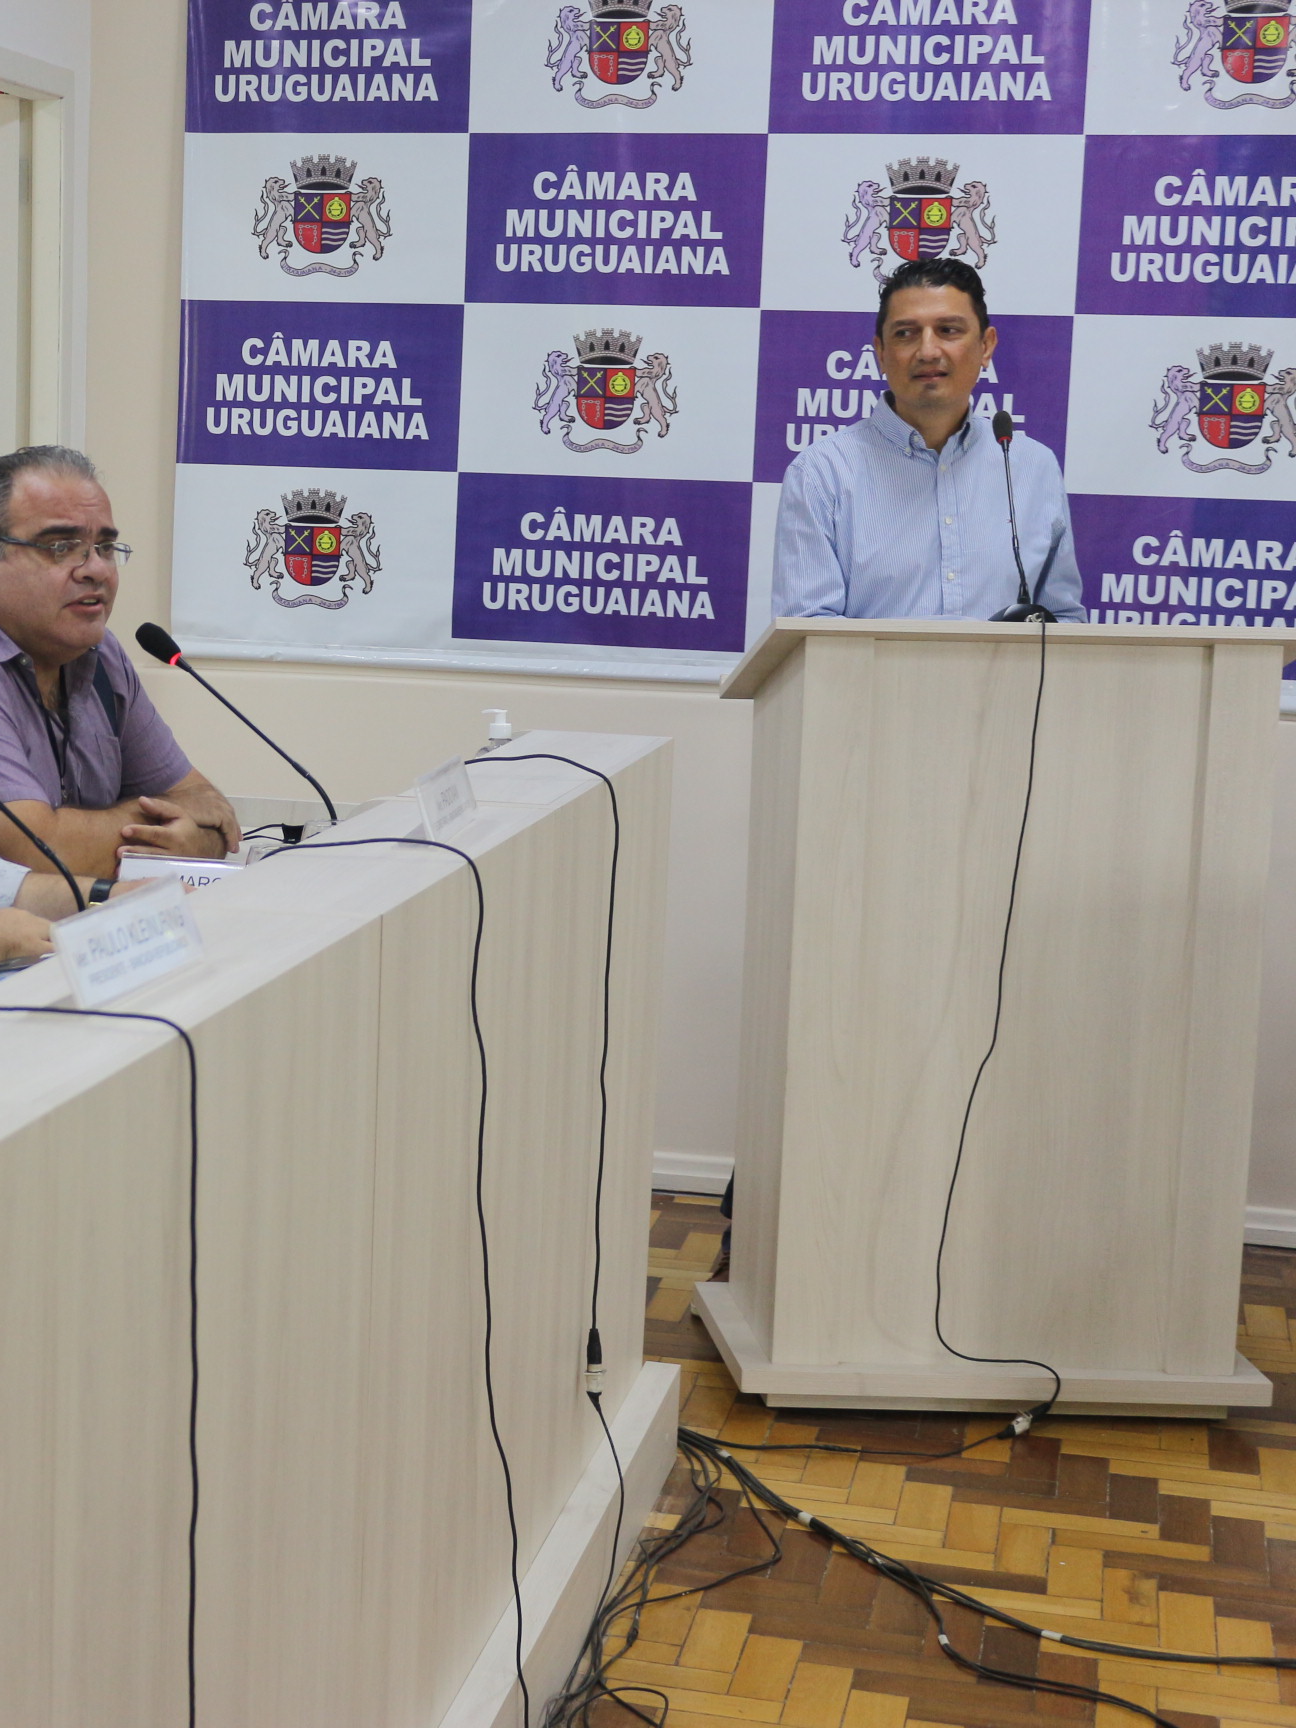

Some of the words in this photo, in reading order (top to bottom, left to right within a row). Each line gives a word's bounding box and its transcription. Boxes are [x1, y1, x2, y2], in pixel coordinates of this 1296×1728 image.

[250, 0, 406, 31] CÂMARA
[224, 38, 431, 67] MUNICIPAL
[813, 35, 1046, 65] MUNICIPAL
[215, 74, 438, 102] URUGUAIANA
[802, 72, 1052, 101] URUGUAIANA
[533, 165, 697, 201] CÂMARA
[506, 209, 723, 239] MUNICIPAL
[496, 244, 730, 275] URUGUAIANA
[1111, 252, 1296, 284] URUGUAI
[242, 332, 397, 368] CÂMARA
[216, 374, 422, 405] MUNICIPAL
[207, 407, 429, 440] URUGUAIANA
[521, 507, 682, 546] CÂMARA
[493, 548, 708, 584] MUNICIPAL
[483, 582, 715, 619] URUGUAIANA
